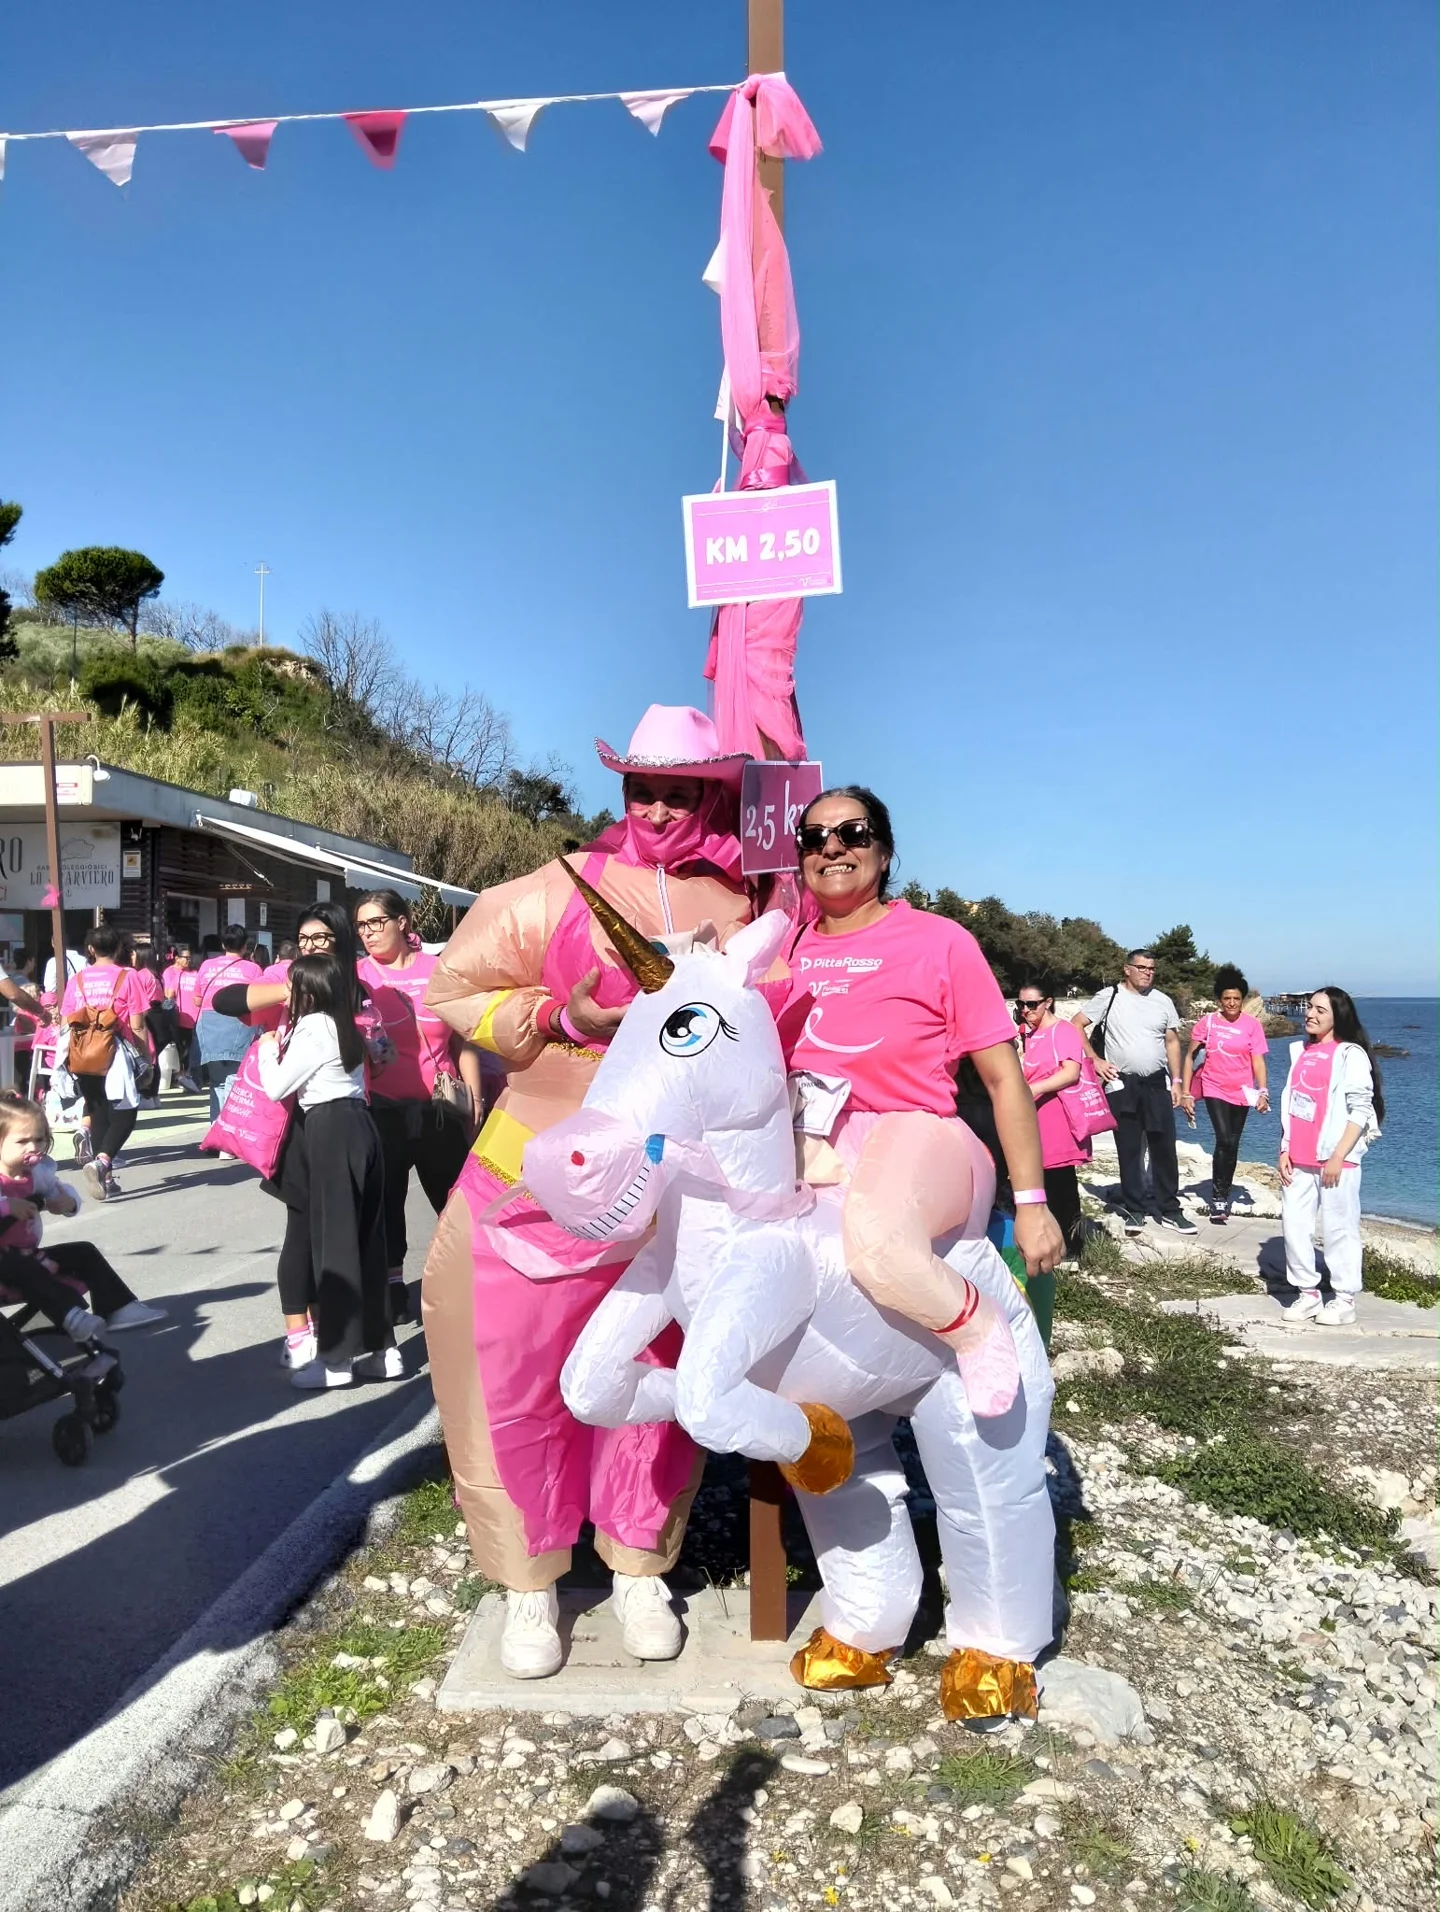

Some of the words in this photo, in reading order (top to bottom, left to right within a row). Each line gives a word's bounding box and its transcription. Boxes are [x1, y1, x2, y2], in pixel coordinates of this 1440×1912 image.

[705, 535, 748, 565] KM
[759, 527, 820, 562] 2,50
[745, 805, 775, 850] 2,5
[30, 871, 42, 885] LO
[813, 956, 883, 969] PittaRosso
